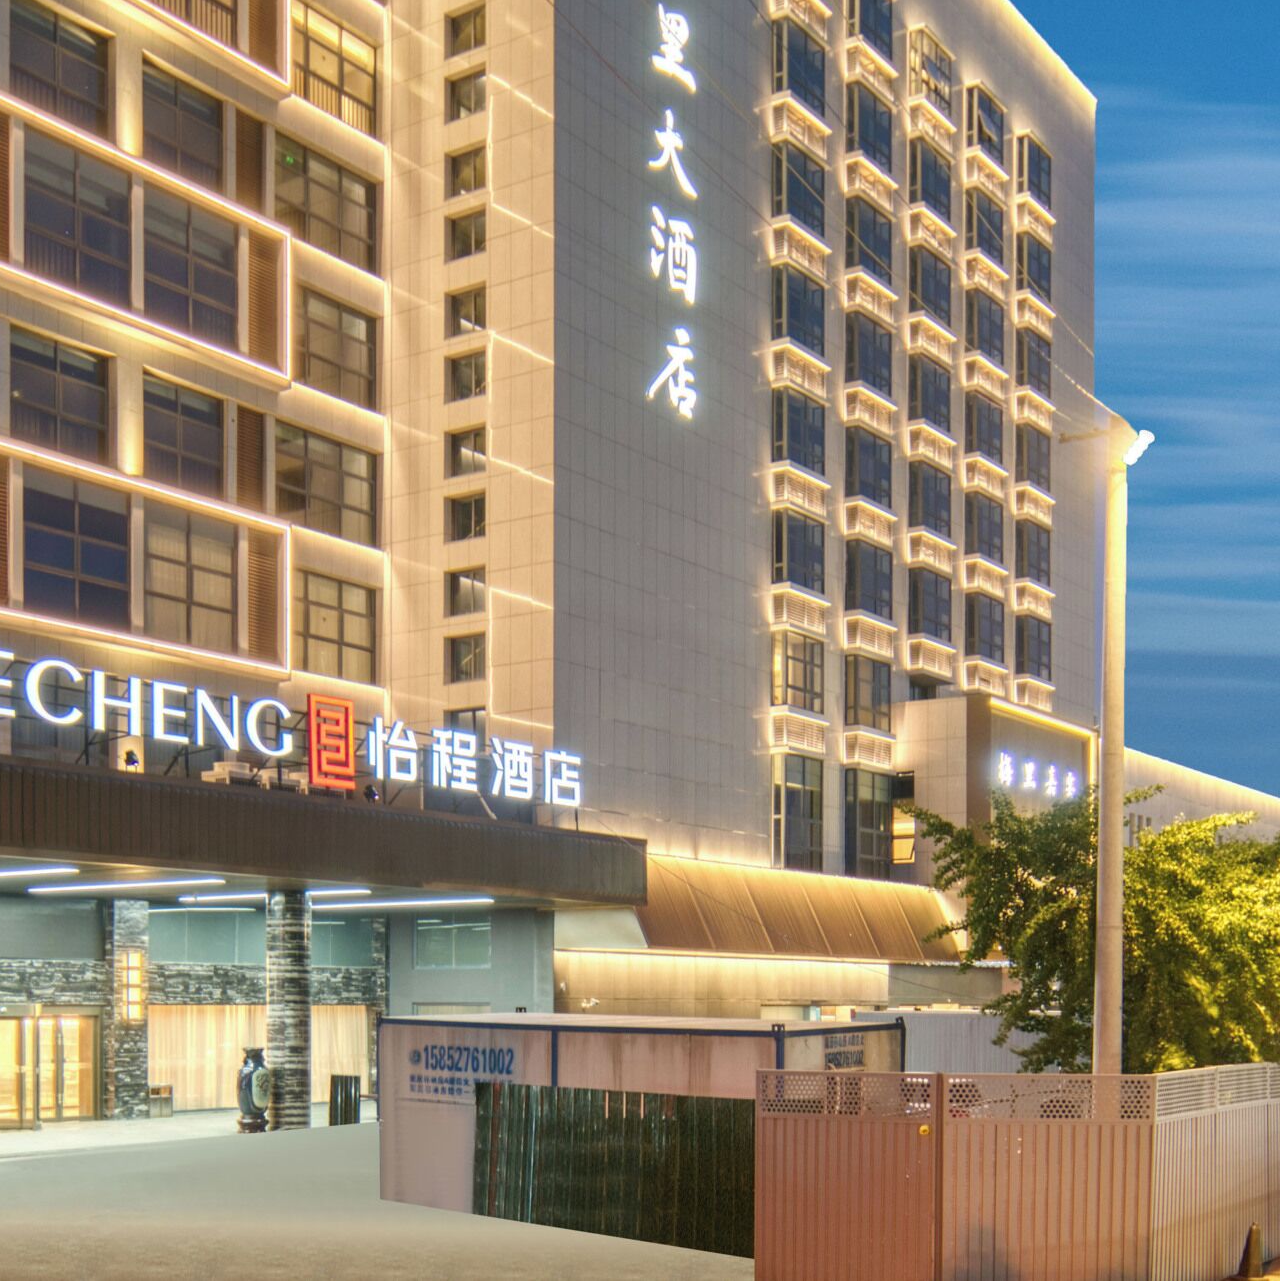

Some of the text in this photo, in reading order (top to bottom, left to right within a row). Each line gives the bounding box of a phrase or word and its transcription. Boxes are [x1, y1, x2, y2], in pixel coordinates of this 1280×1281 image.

[367, 715, 583, 808] 怡程酒店
[423, 1044, 515, 1075] 15852761002
